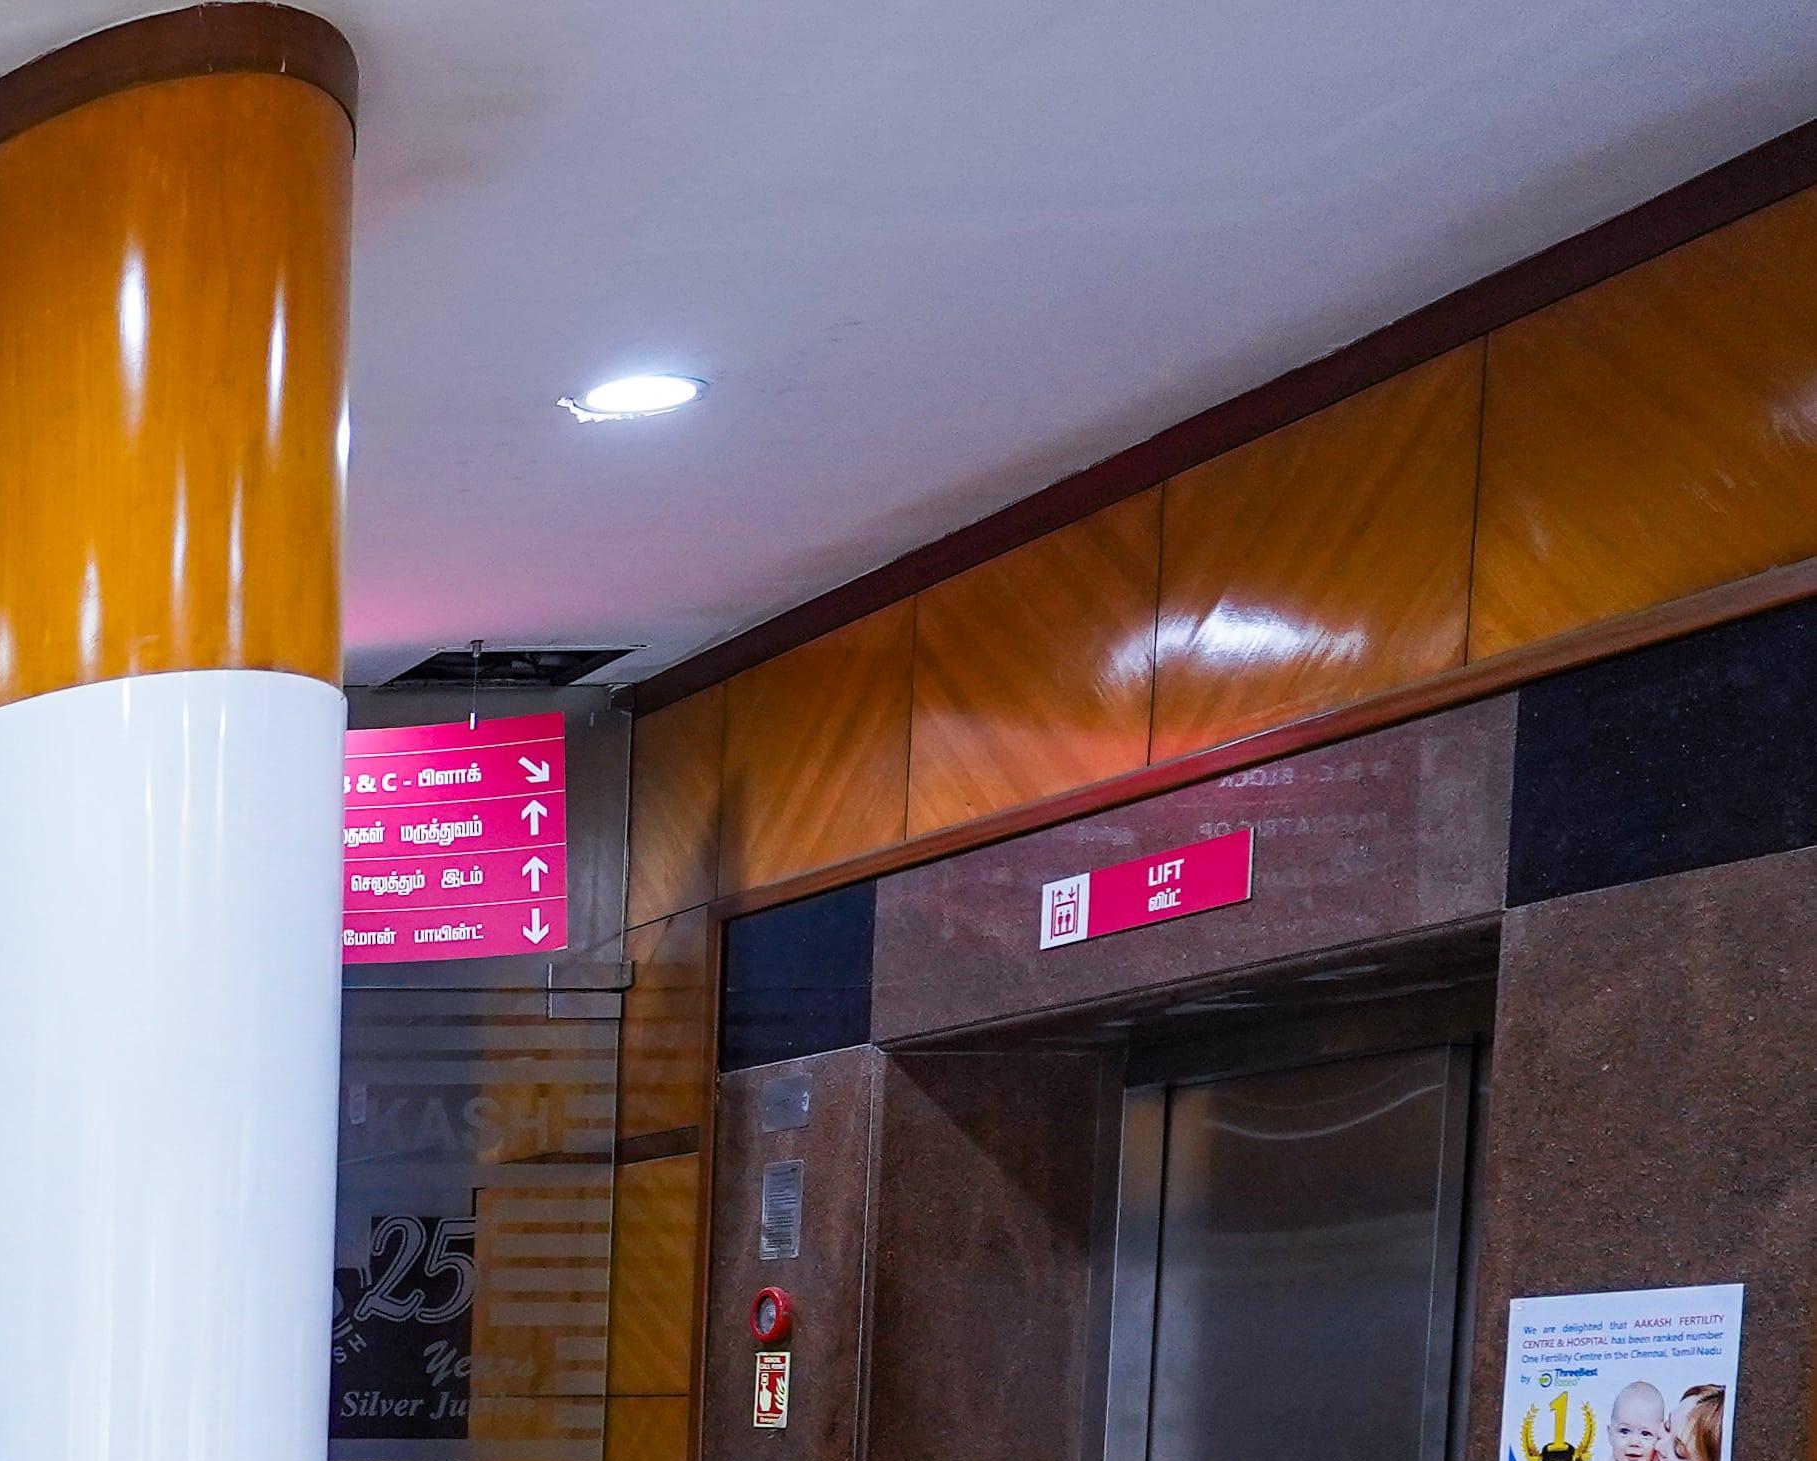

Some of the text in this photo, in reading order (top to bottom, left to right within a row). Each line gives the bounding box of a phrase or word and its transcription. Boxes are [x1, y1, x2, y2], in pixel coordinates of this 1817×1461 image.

[356, 774, 377, 793] &
[382, 773, 397, 791] C
[1148, 859, 1185, 886] LIFT
[354, 1215, 477, 1324] 25
[1524, 1315, 1725, 1335] We are delighted that AAKASH FERTILITY
[1523, 1331, 1723, 1349] CENTRE & HOSPITAL has been ranked number
[1522, 1355, 1538, 1363] One
[1541, 1353, 1571, 1364] Fertility
[1574, 1352, 1601, 1361] Centre
[1615, 1351, 1629, 1359] the
[1672, 1348, 1694, 1356] Tamil
[1696, 1346, 1722, 1356] Nadu
[1521, 1375, 1530, 1384] by
[340, 1391, 424, 1417] Silver
